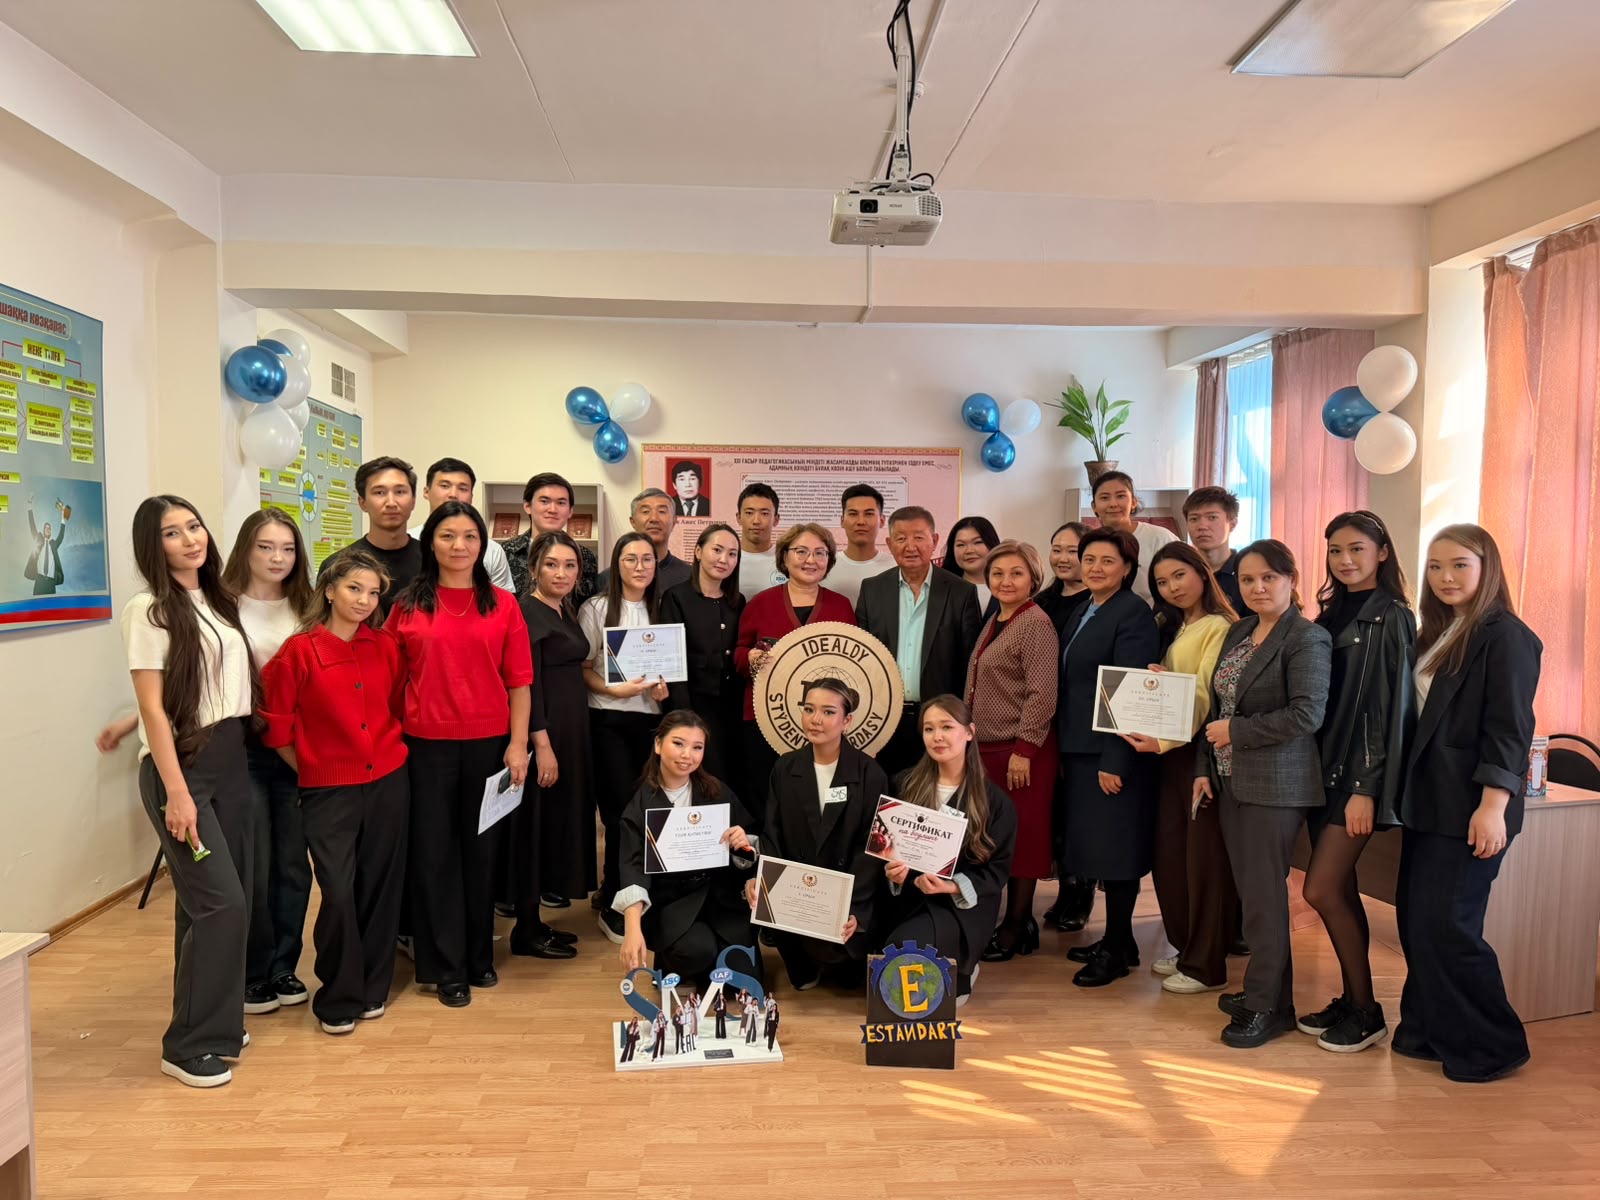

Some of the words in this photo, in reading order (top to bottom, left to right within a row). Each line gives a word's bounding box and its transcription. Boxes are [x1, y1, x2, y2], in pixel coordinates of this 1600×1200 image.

[801, 637, 870, 663] IDEALDY
[849, 711, 883, 748] RDASY
[890, 815, 954, 840] СЕРТИФИКАТ
[664, 976, 681, 985] ISO
[715, 971, 729, 979] IAF
[899, 964, 928, 1013] E
